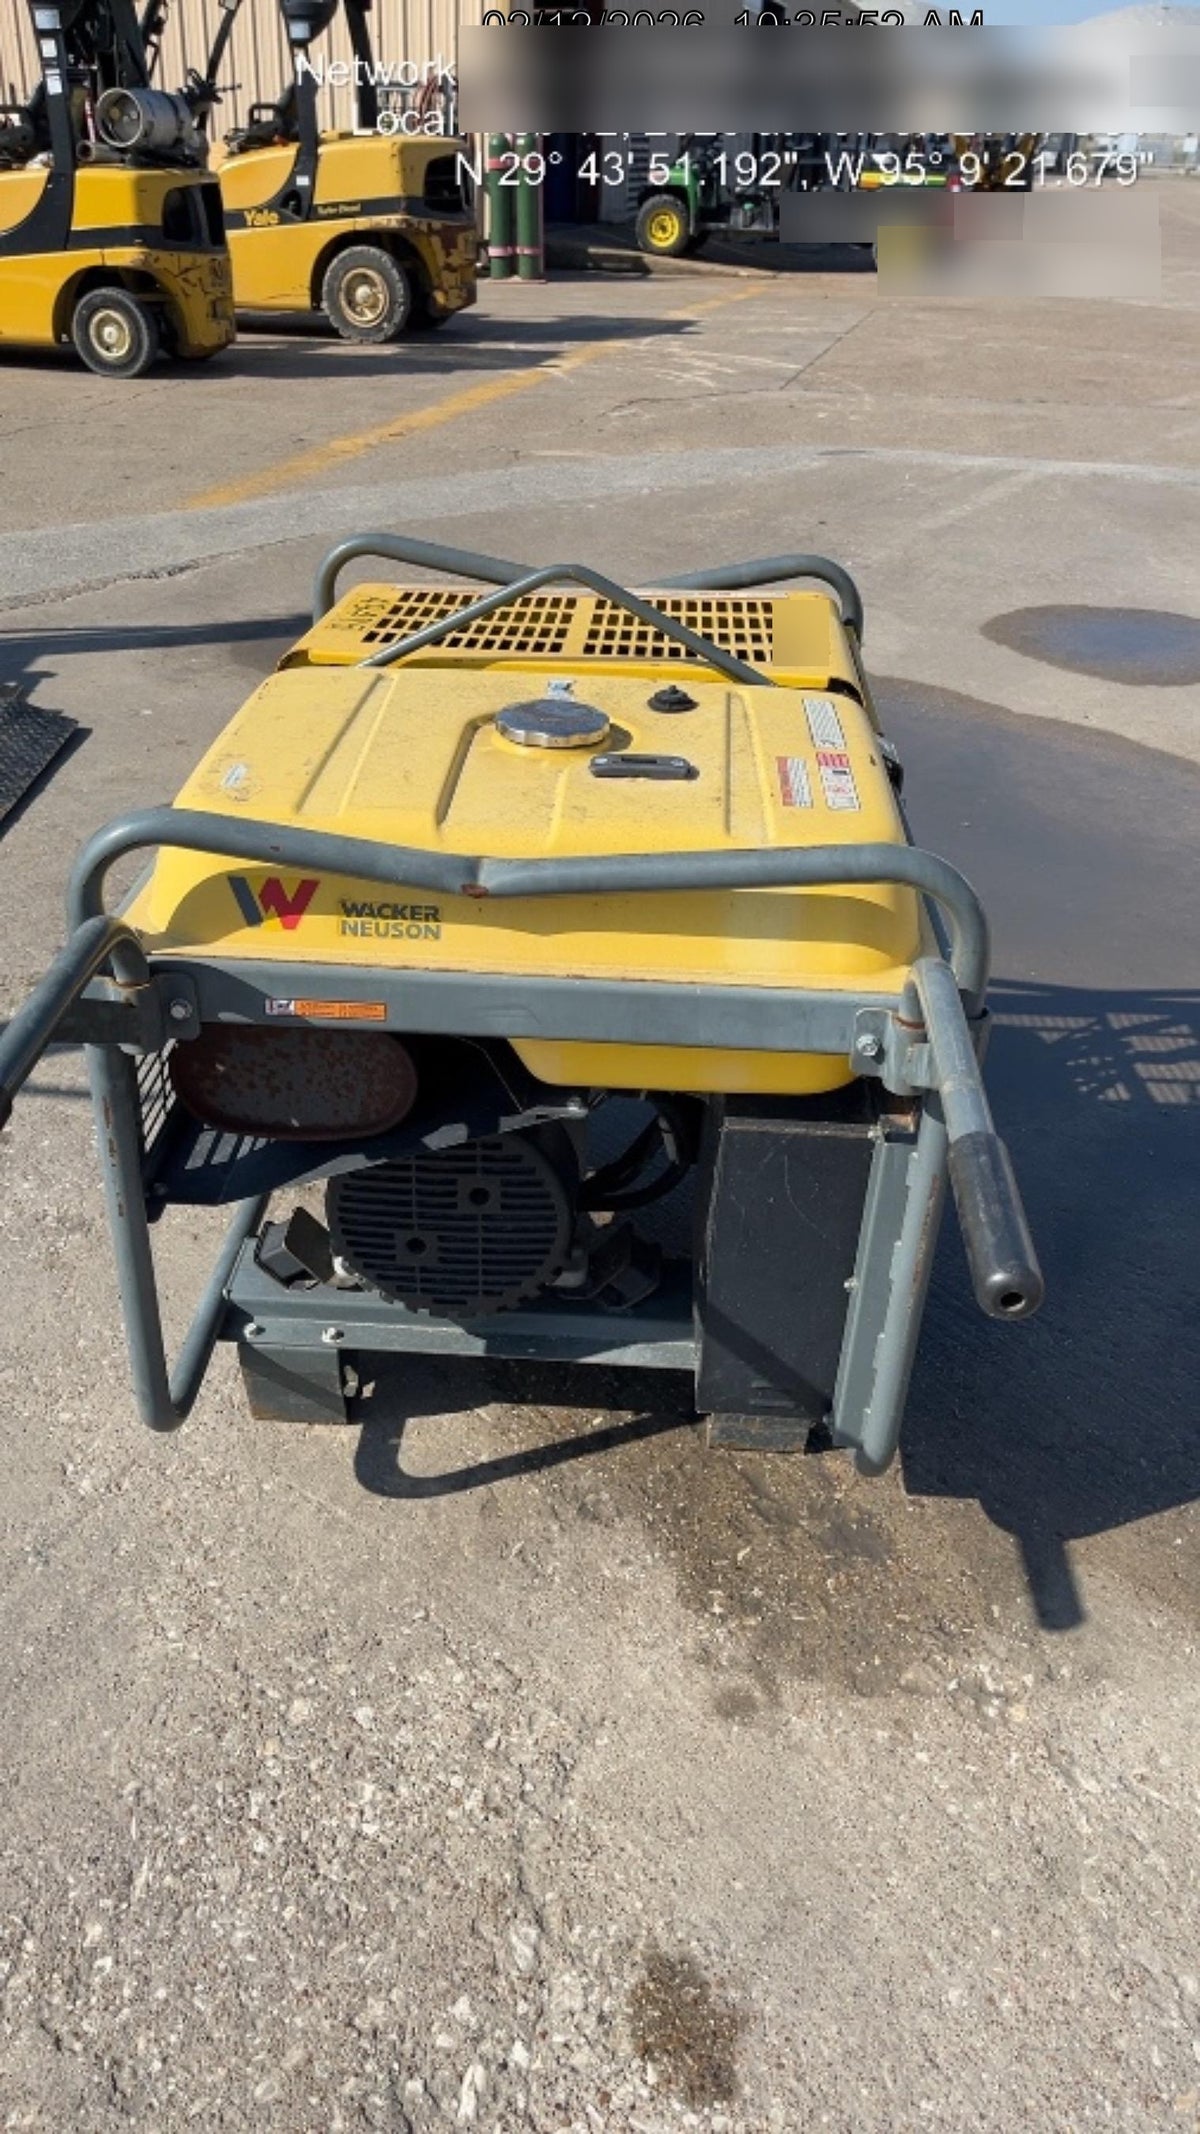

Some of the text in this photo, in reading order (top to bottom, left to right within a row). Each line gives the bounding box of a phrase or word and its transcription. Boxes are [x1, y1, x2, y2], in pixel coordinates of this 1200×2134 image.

[244, 209, 279, 227] Yale
[339, 900, 442, 922] WACKER
[340, 920, 442, 940] NEUSON
